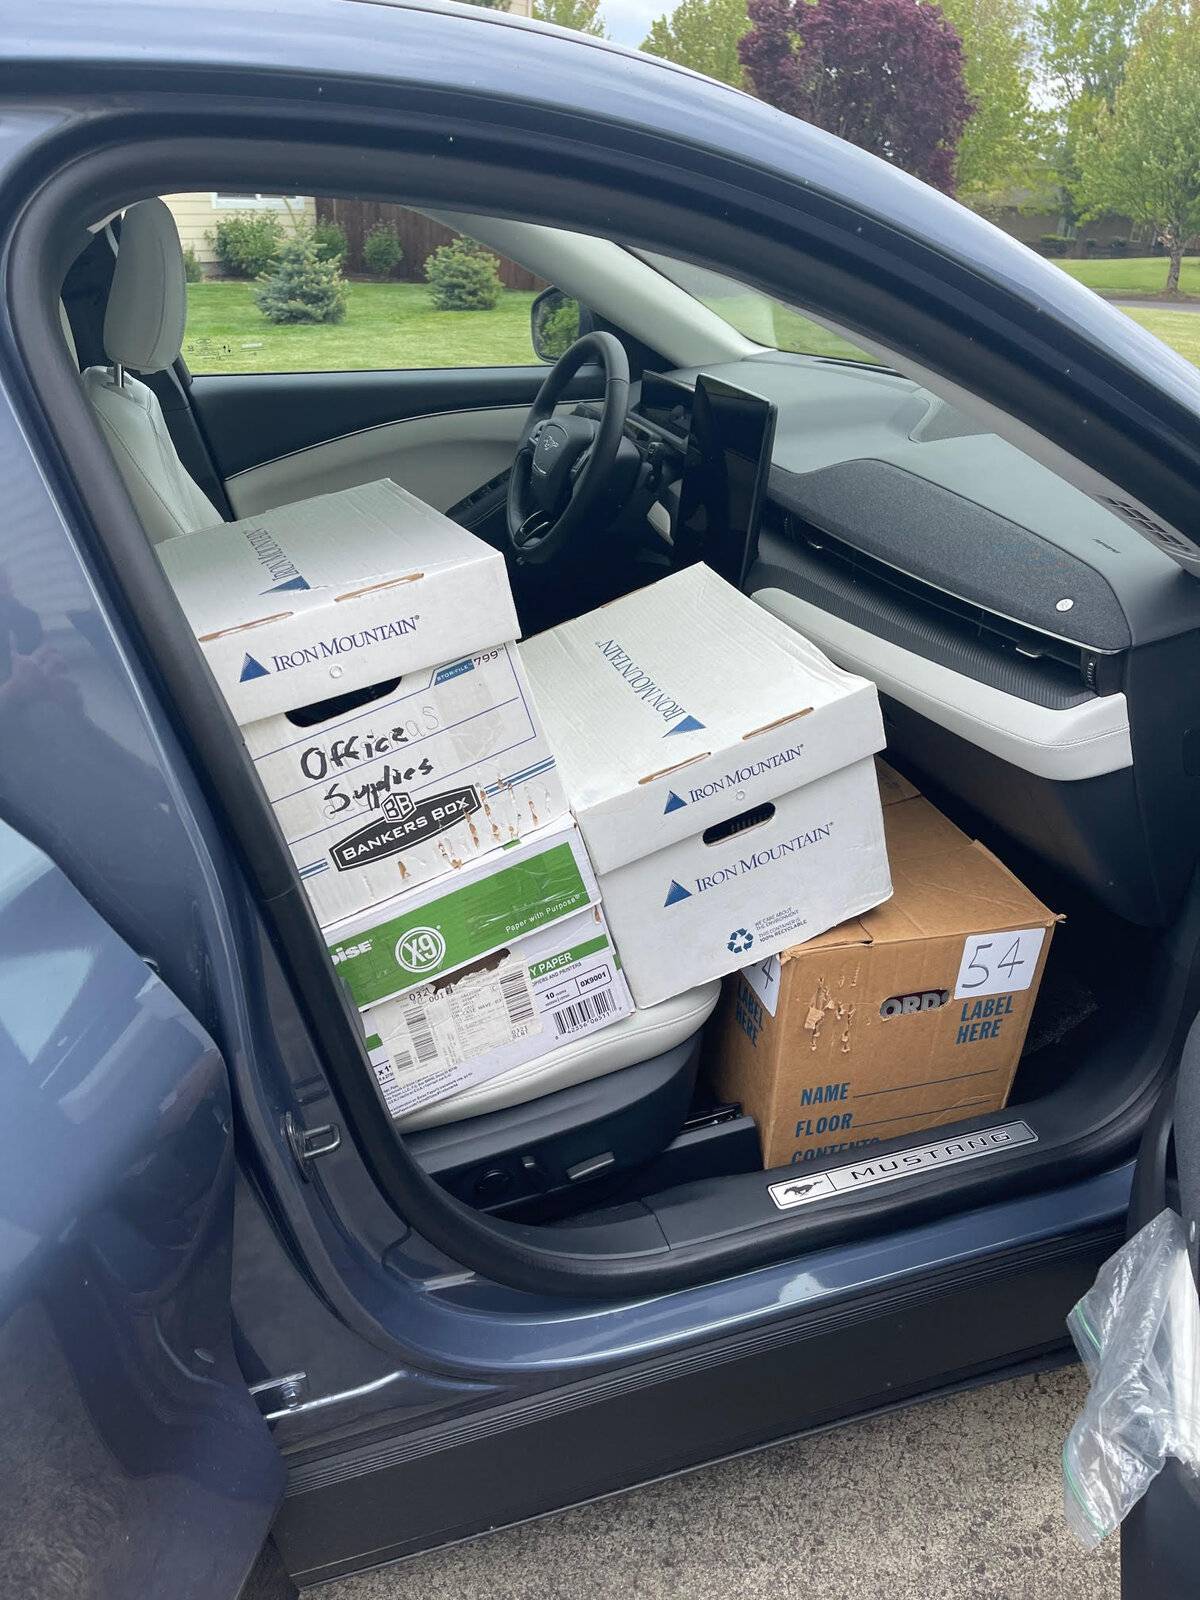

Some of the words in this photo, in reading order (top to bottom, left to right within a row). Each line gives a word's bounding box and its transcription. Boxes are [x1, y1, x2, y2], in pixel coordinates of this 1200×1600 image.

[271, 646, 320, 672] IRON
[648, 694, 686, 722] IRON
[301, 727, 409, 780] Office
[688, 779, 725, 803] IRON
[342, 816, 428, 860] BANKERS
[431, 797, 470, 821] BOX
[695, 864, 738, 892] IRON
[505, 920, 527, 934] Paper
[529, 911, 545, 922] with
[774, 920, 807, 936] RECYCLABLE
[403, 934, 438, 966] X9
[538, 952, 573, 973] PAPER
[962, 937, 1025, 988] 54
[560, 962, 582, 975] PRINTERS
[545, 992, 554, 1000] 10
[960, 995, 1015, 1022] LABEL
[956, 1019, 1003, 1045] HERE
[800, 1082, 851, 1106] NAME
[795, 1112, 853, 1138] FLOOR
[851, 1130, 1012, 1180] MUSTANG
